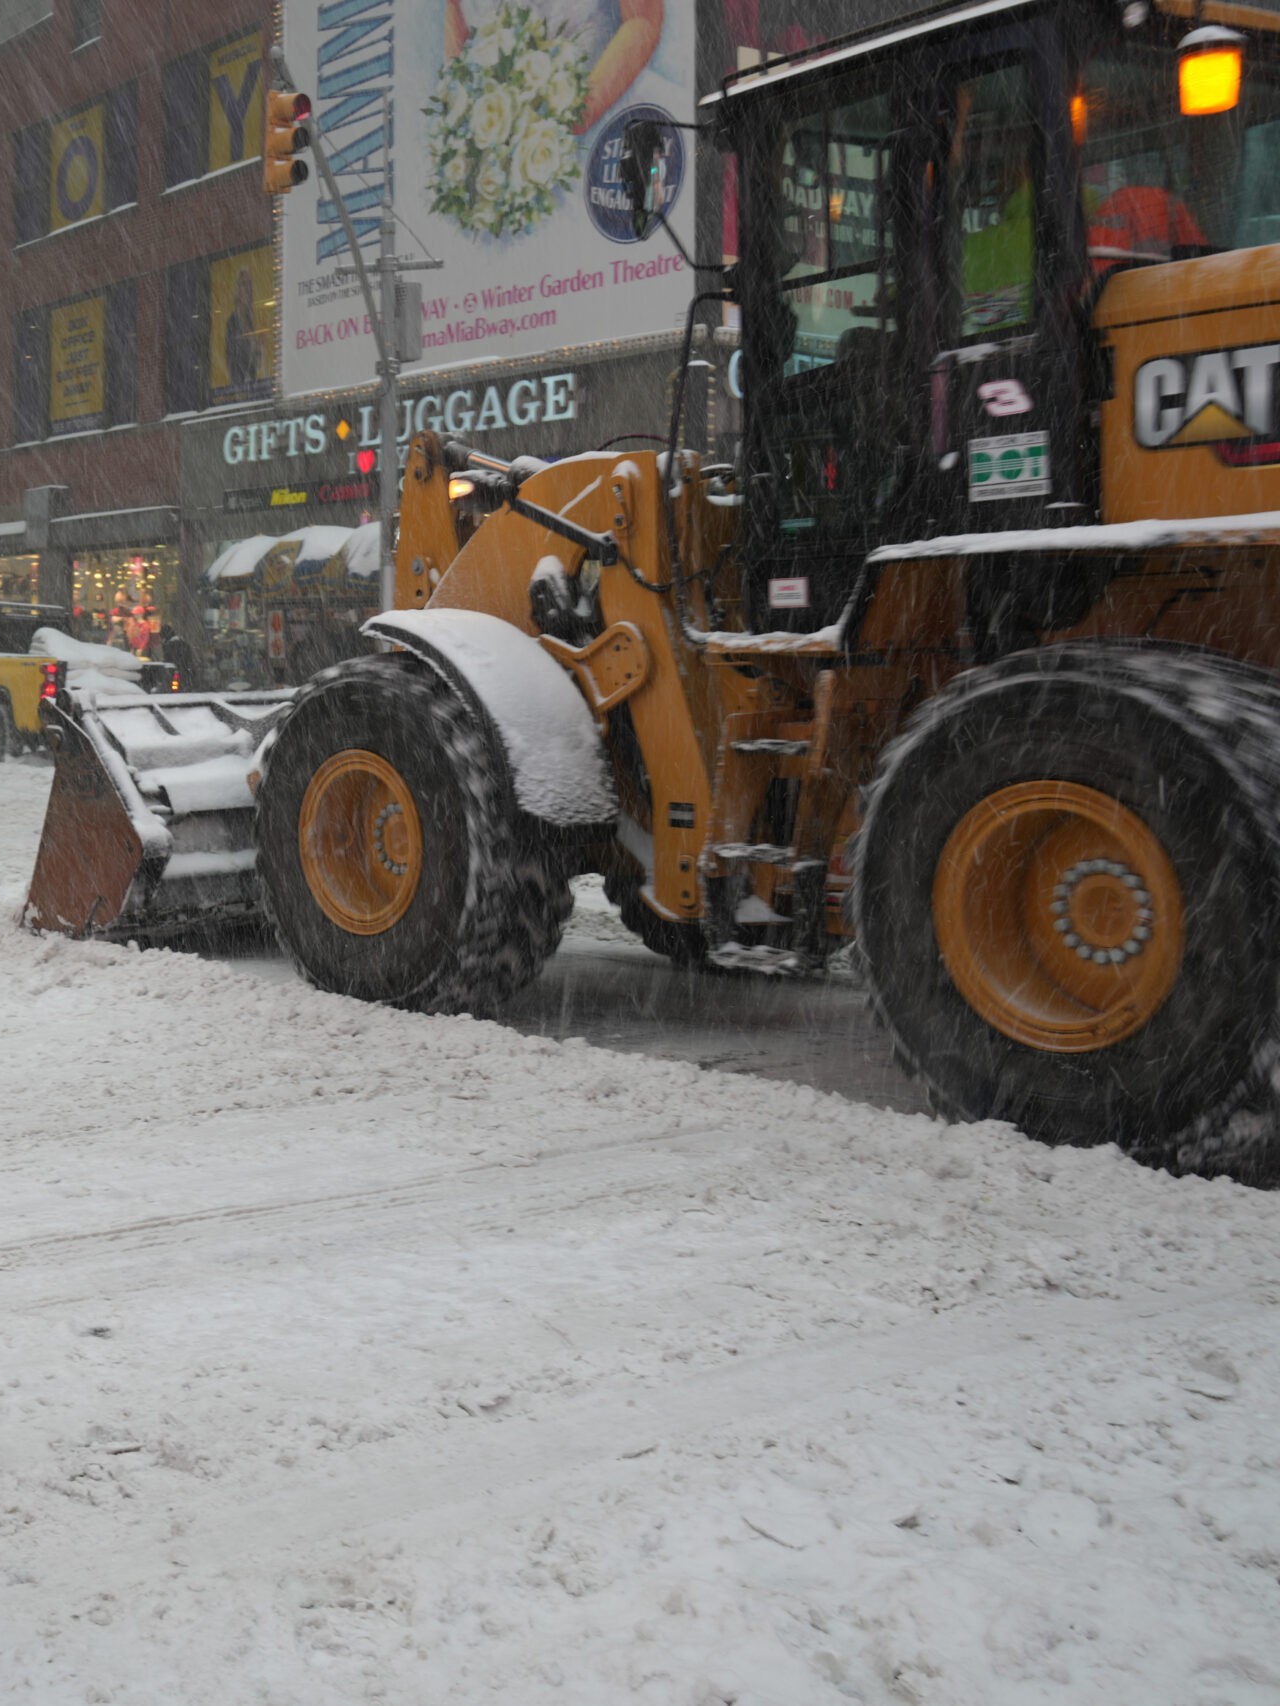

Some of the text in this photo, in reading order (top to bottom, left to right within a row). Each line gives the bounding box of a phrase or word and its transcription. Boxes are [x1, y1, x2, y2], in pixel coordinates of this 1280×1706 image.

[210, 58, 263, 162] Y
[296, 321, 334, 350] BACK
[336, 316, 359, 341] ON
[481, 283, 535, 311] Winter
[540, 269, 604, 298] Garden
[609, 252, 685, 285] Theatre
[223, 372, 576, 465] GIFTS LUGGAGE
[977, 379, 1033, 417] 3
[1135, 345, 1280, 448] CAT
[270, 488, 308, 506] Nikon
[320, 483, 370, 502] Canon
[970, 445, 1047, 483] DOT
